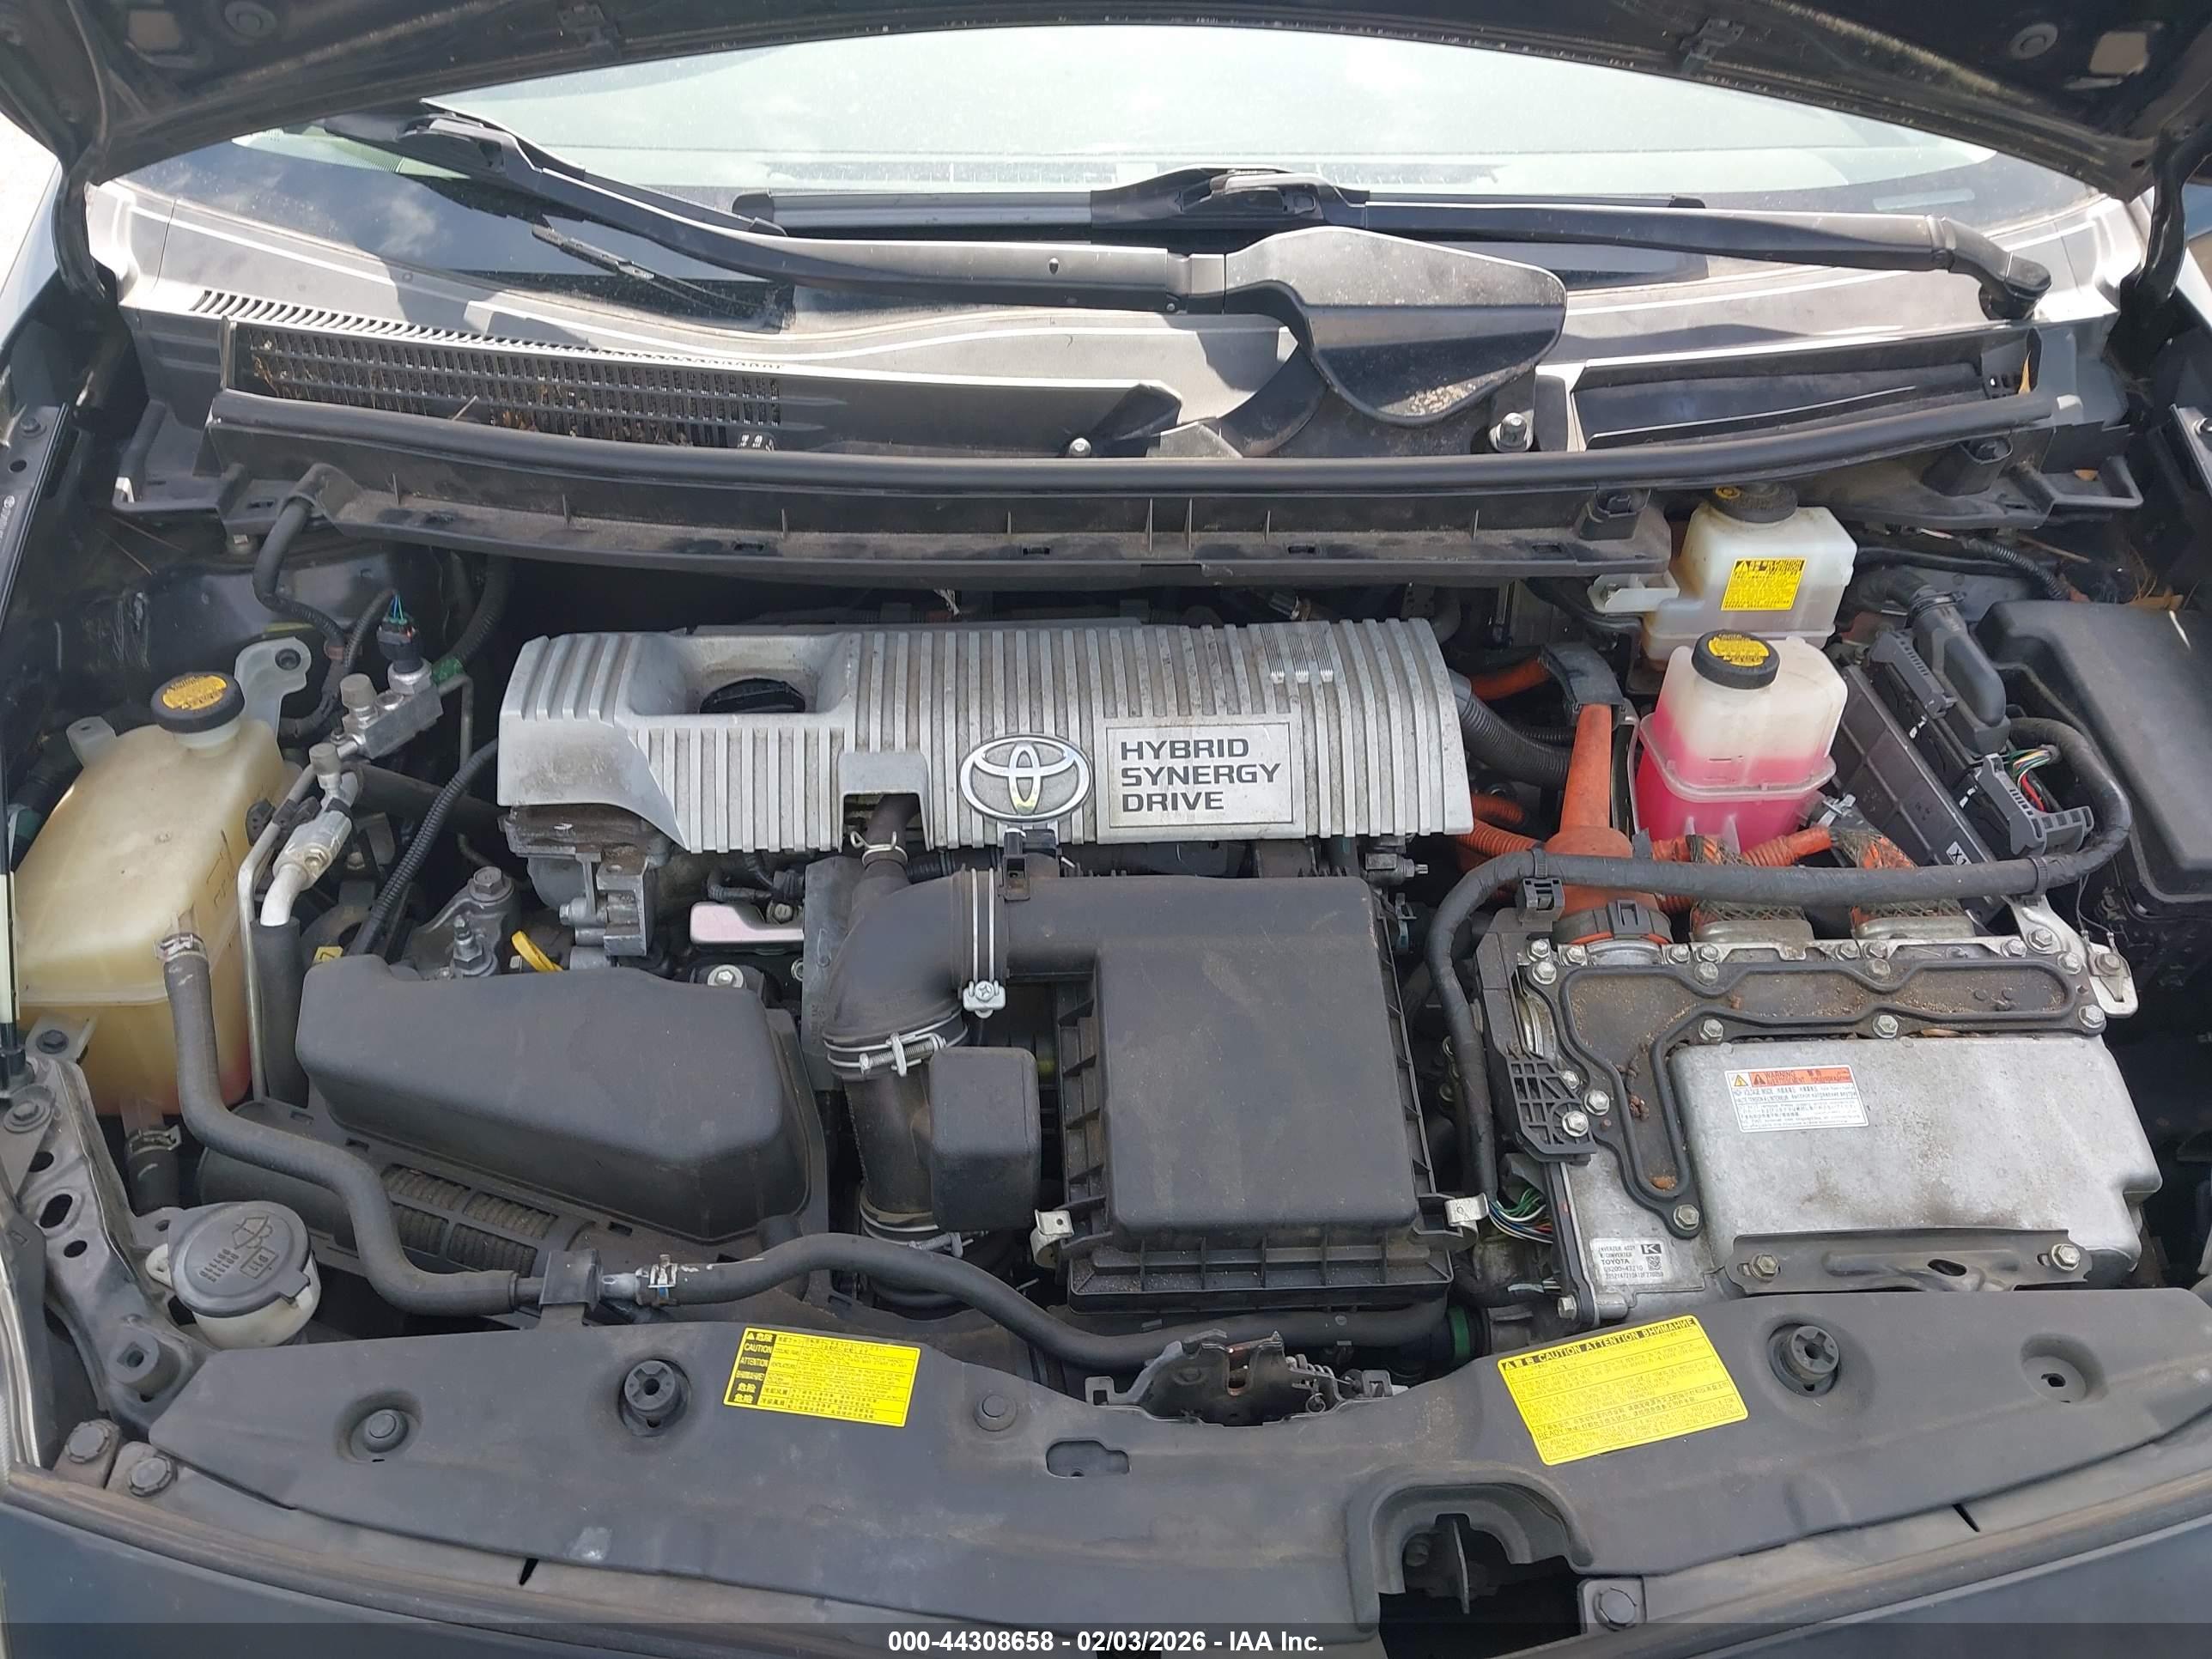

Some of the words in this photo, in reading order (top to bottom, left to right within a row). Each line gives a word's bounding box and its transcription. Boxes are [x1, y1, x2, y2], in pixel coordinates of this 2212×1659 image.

[1121, 738, 1249, 760] HYBRID
[1121, 763, 1281, 787] SYNERGY
[1122, 792, 1224, 812] DRIVE
[1643, 1318, 1694, 1336] ВНИМАНИЕ
[744, 1342, 773, 1353] CAUTION
[1538, 1346, 1582, 1362] CAUTION
[1586, 1332, 1638, 1351] ATTENTION
